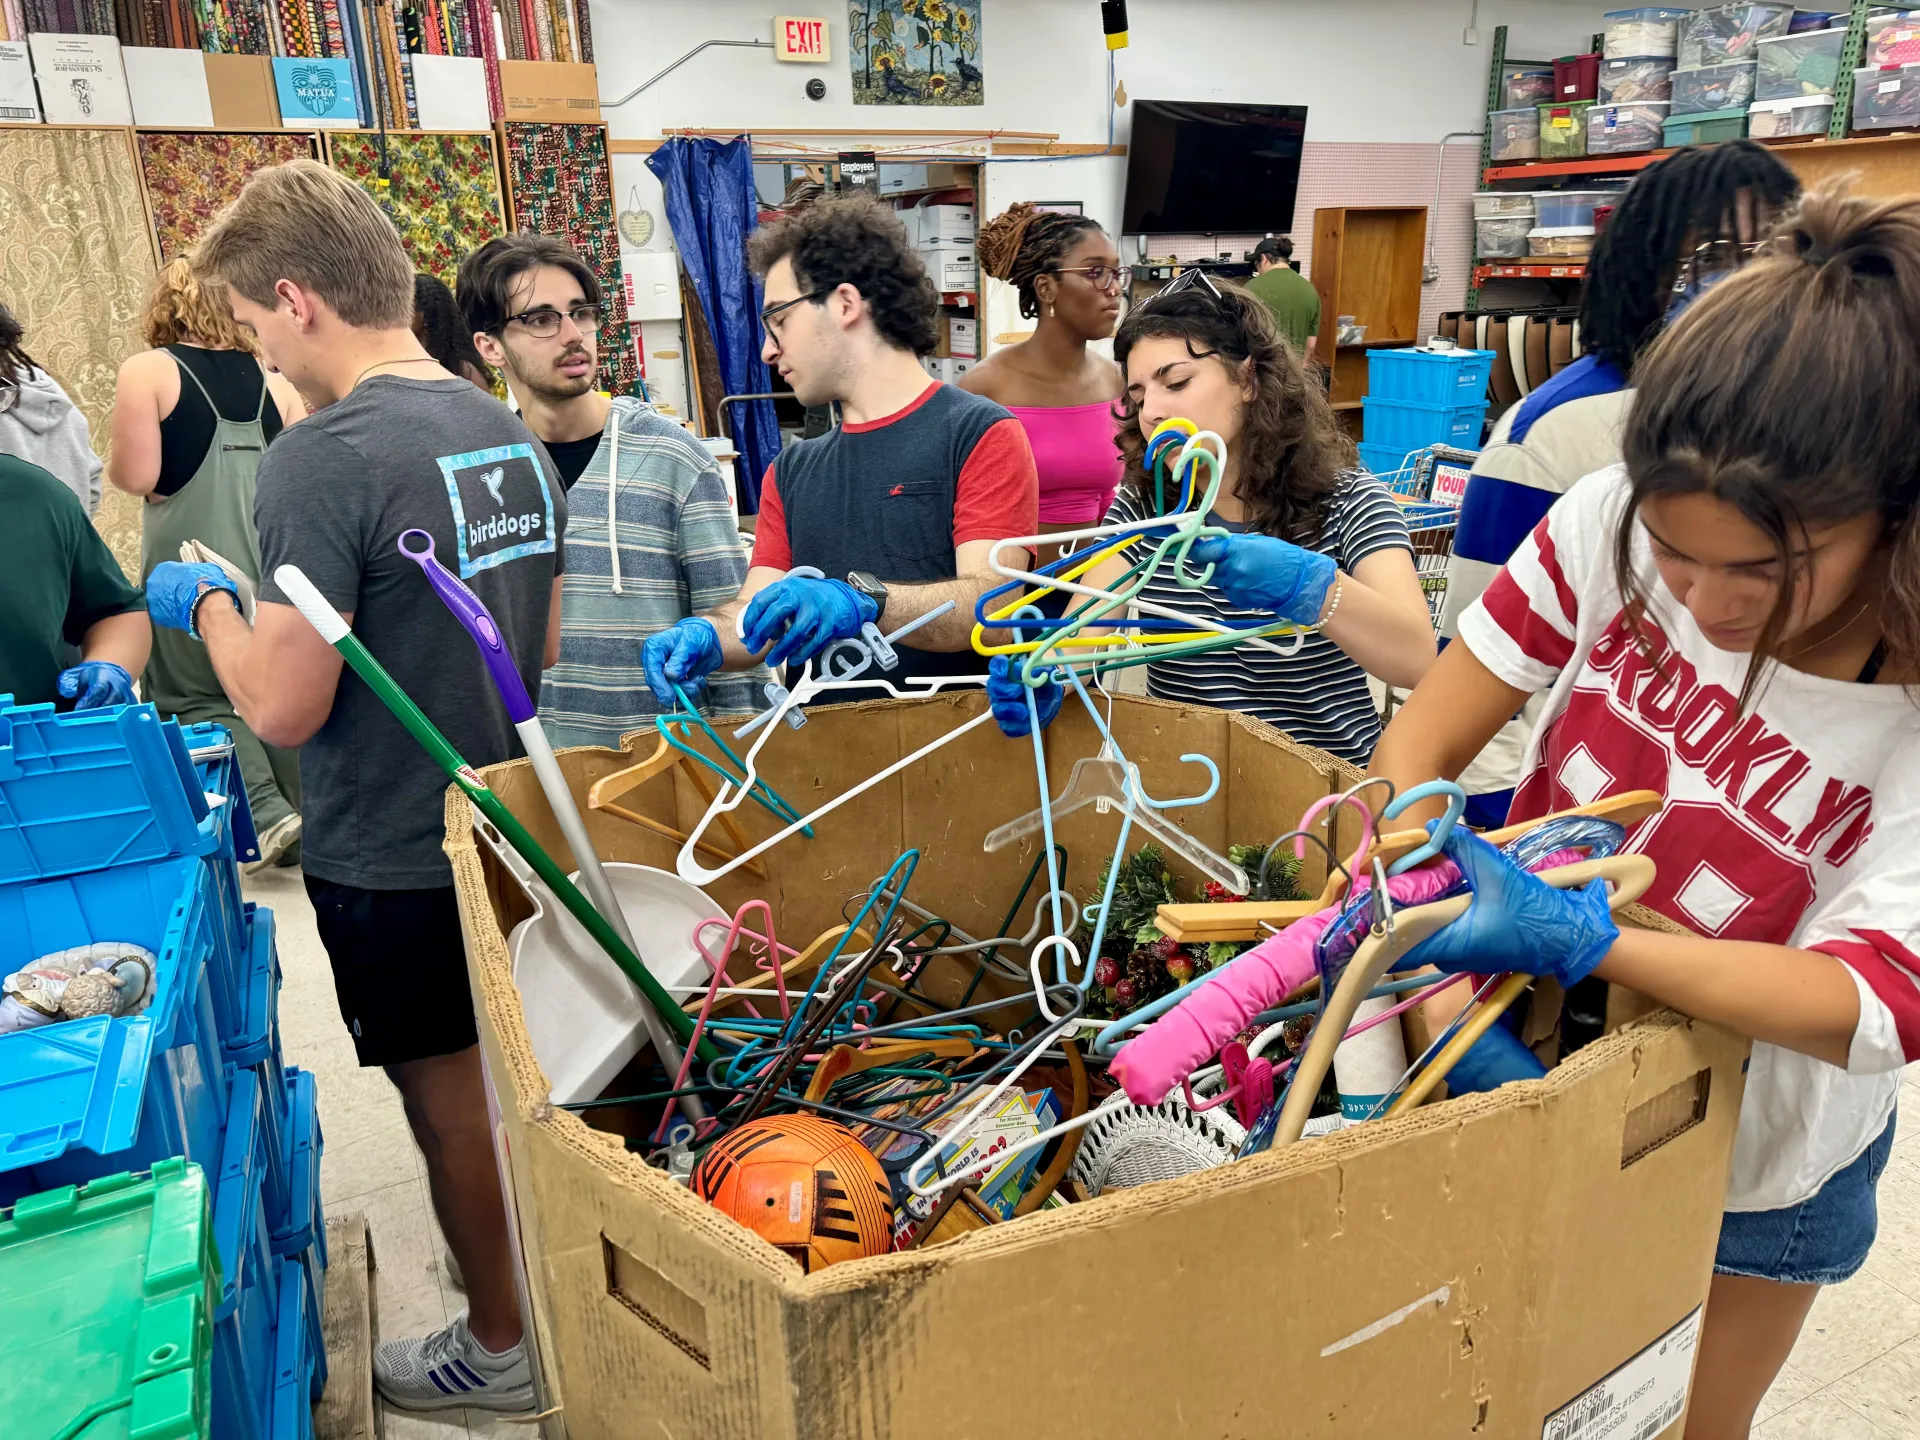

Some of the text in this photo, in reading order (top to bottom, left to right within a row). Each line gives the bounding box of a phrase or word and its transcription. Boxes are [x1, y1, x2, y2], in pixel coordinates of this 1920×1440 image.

[785, 20, 823, 54] EXIT
[297, 88, 335, 97] MATUA
[840, 162, 875, 173] Employees
[851, 174, 866, 185] Only
[623, 273, 636, 306] First Aid
[1443, 467, 1472, 479] THIS COU
[1436, 474, 1466, 496] YOUR
[468, 512, 541, 548] birddogs
[456, 765, 486, 788] LIBMAN
[970, 1147, 980, 1159] IS
[916, 1197, 928, 1210] IN
[1549, 1384, 1606, 1436] PSM18386
[1609, 1402, 1622, 1420] PS
